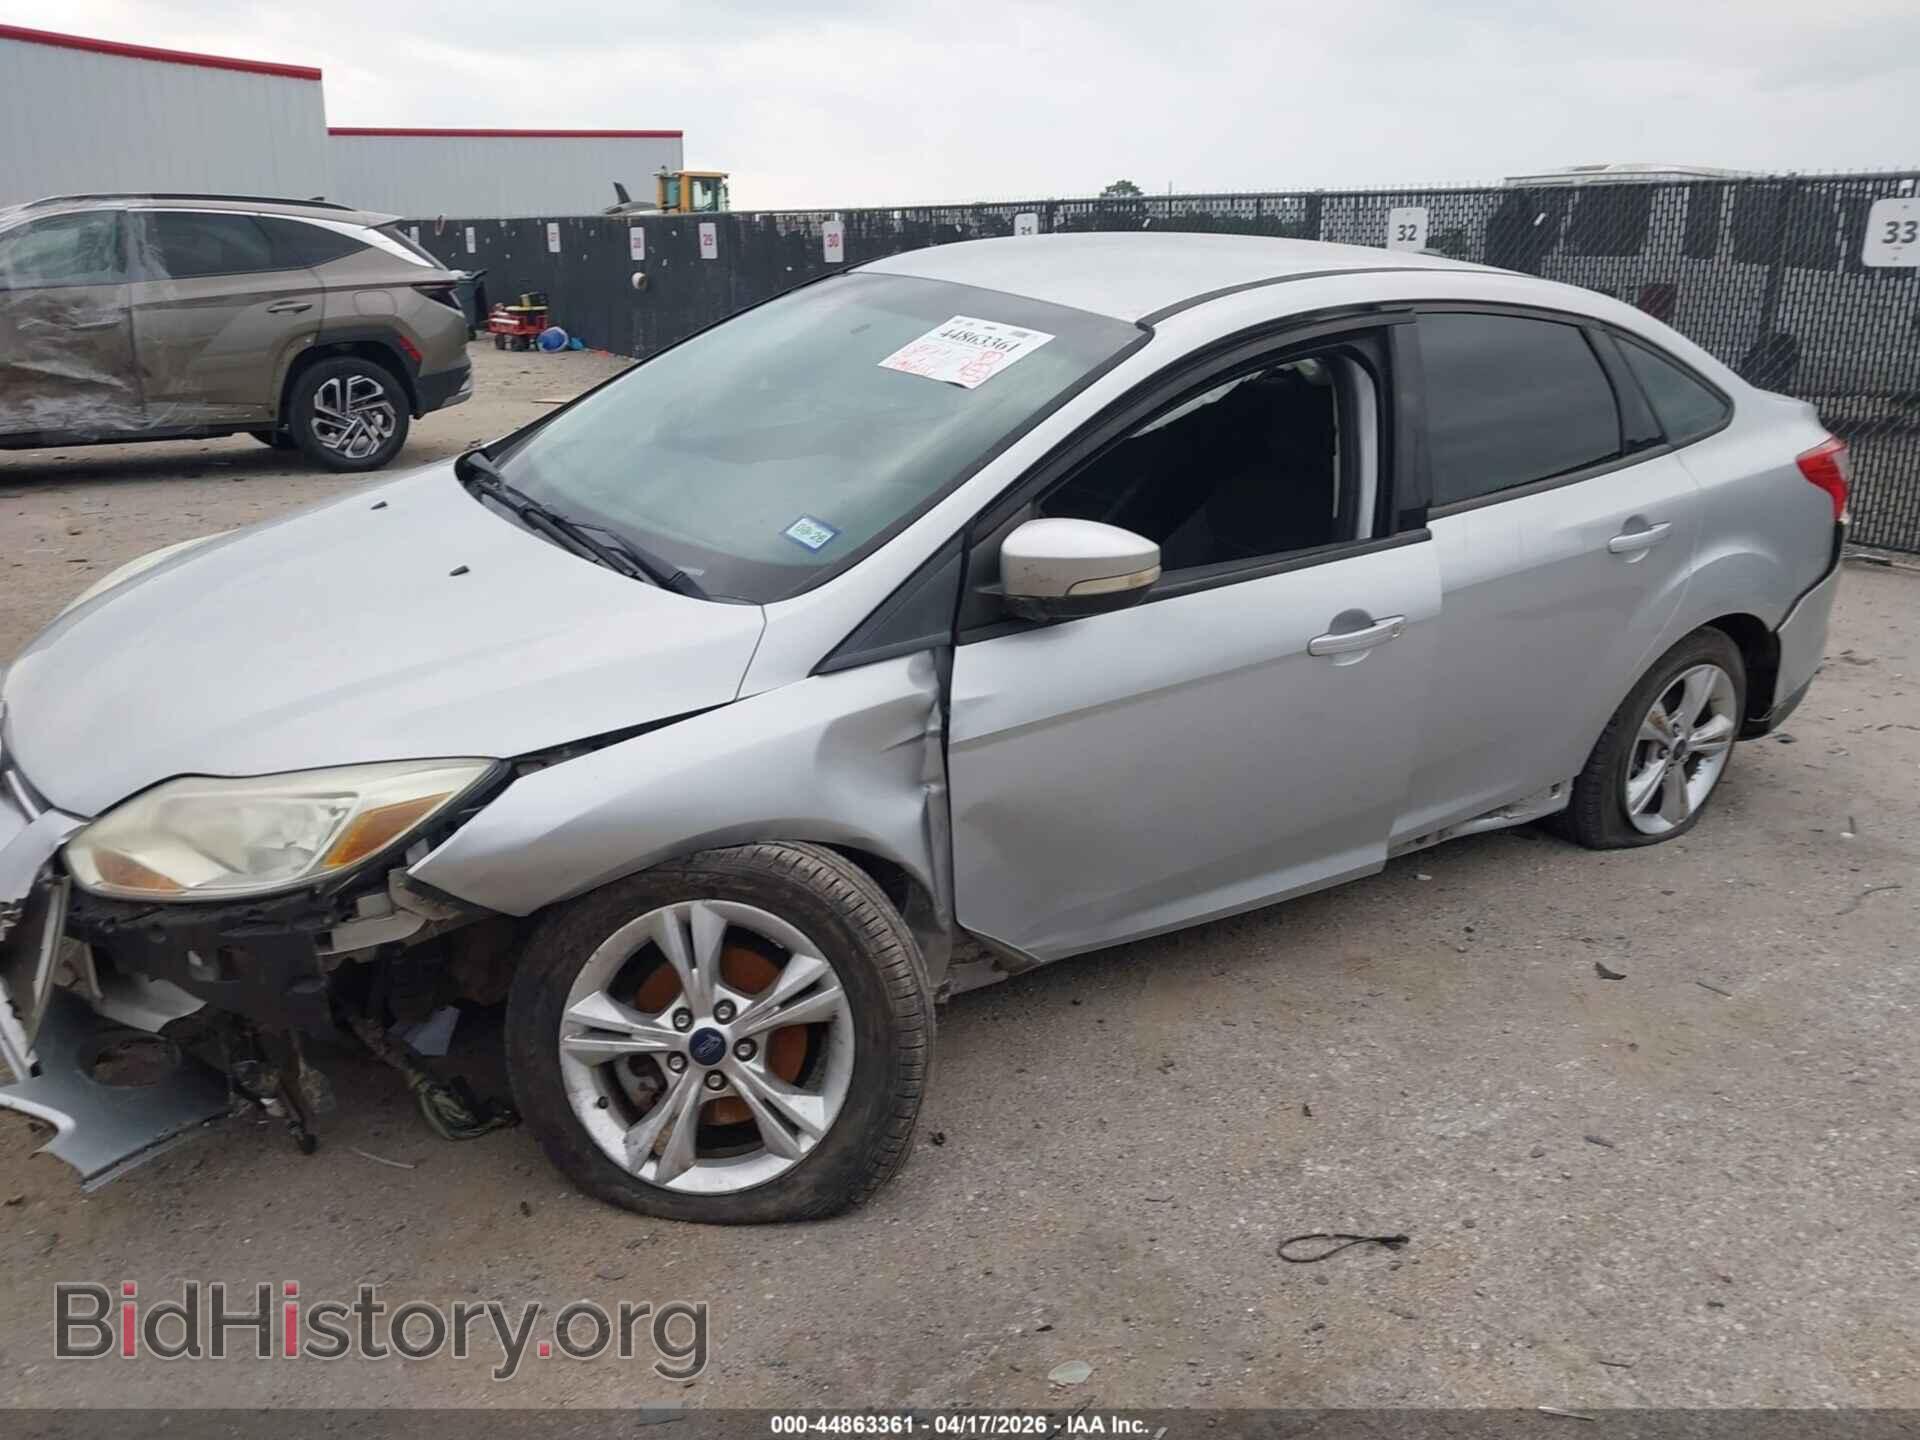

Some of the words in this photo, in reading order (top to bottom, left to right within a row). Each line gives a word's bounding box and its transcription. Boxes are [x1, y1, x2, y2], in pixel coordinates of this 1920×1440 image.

[1397, 224, 1417, 241] 32
[1882, 221, 1918, 244] 33
[940, 328, 1022, 353] 44863361
